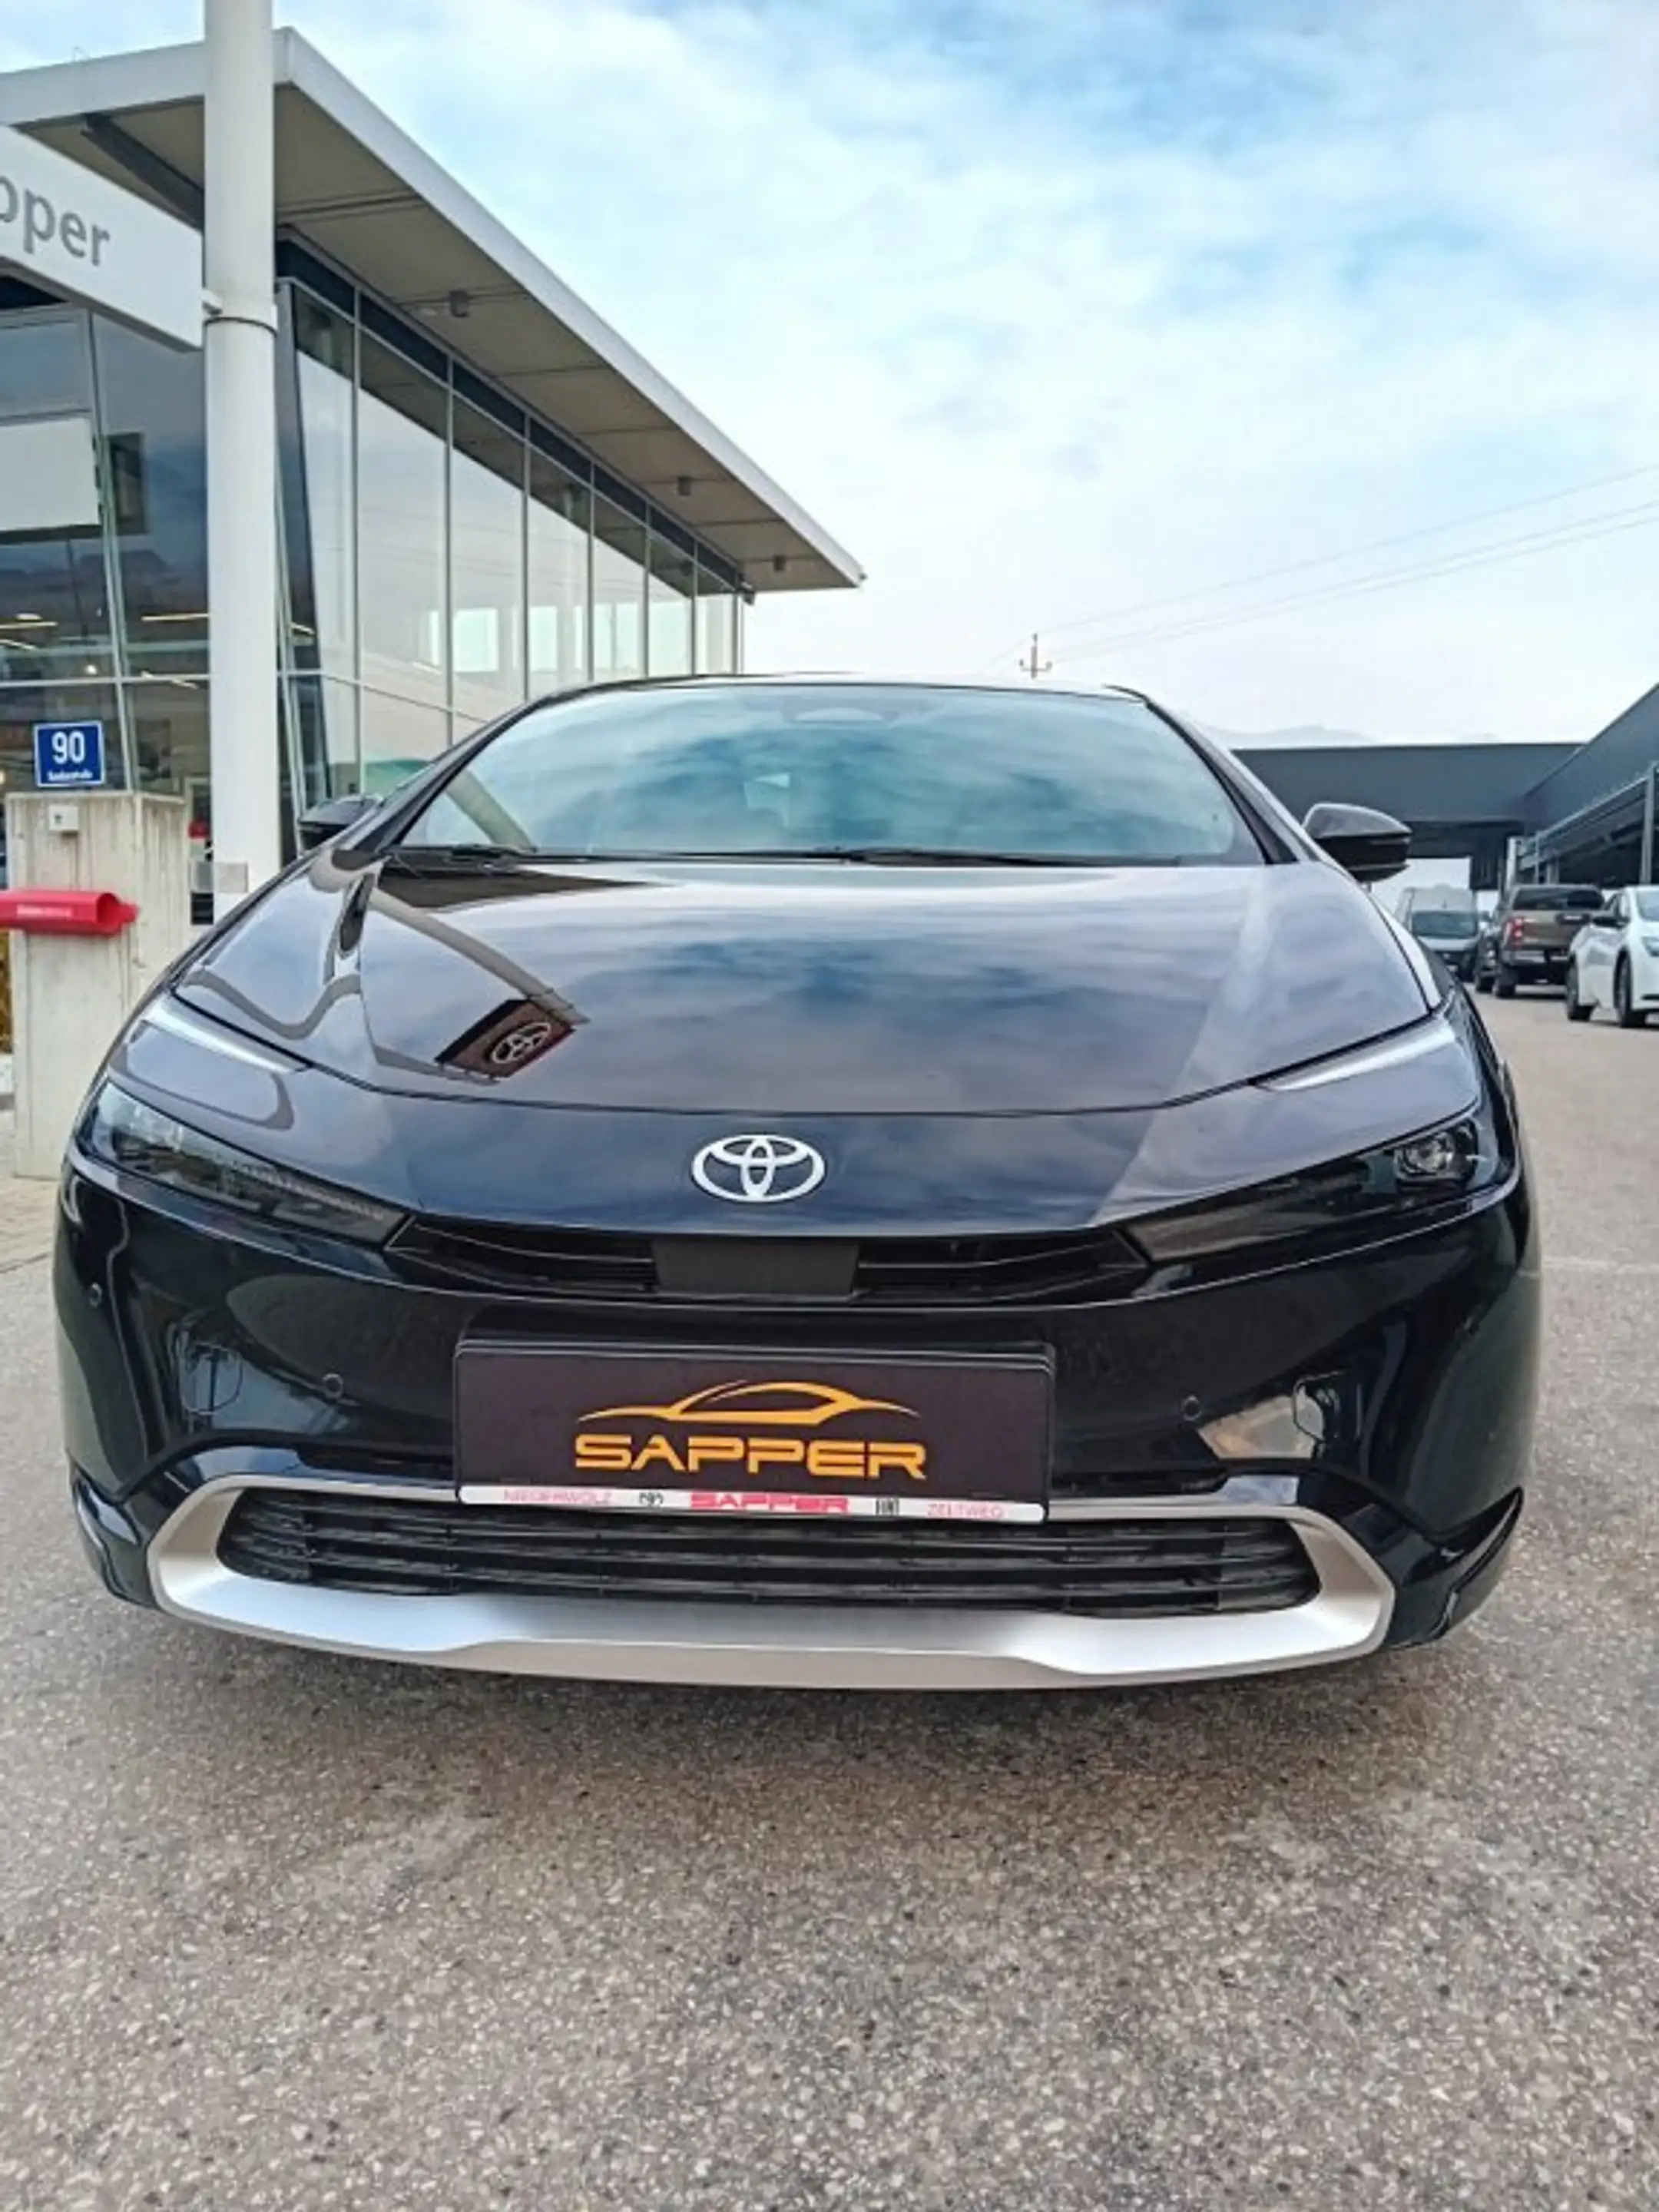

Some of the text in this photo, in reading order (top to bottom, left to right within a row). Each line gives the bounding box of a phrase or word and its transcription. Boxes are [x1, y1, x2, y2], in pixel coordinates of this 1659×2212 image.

[51, 730, 85, 765] 90
[575, 1433, 927, 1480] SAPPER
[690, 1491, 849, 1513] SAPPER
